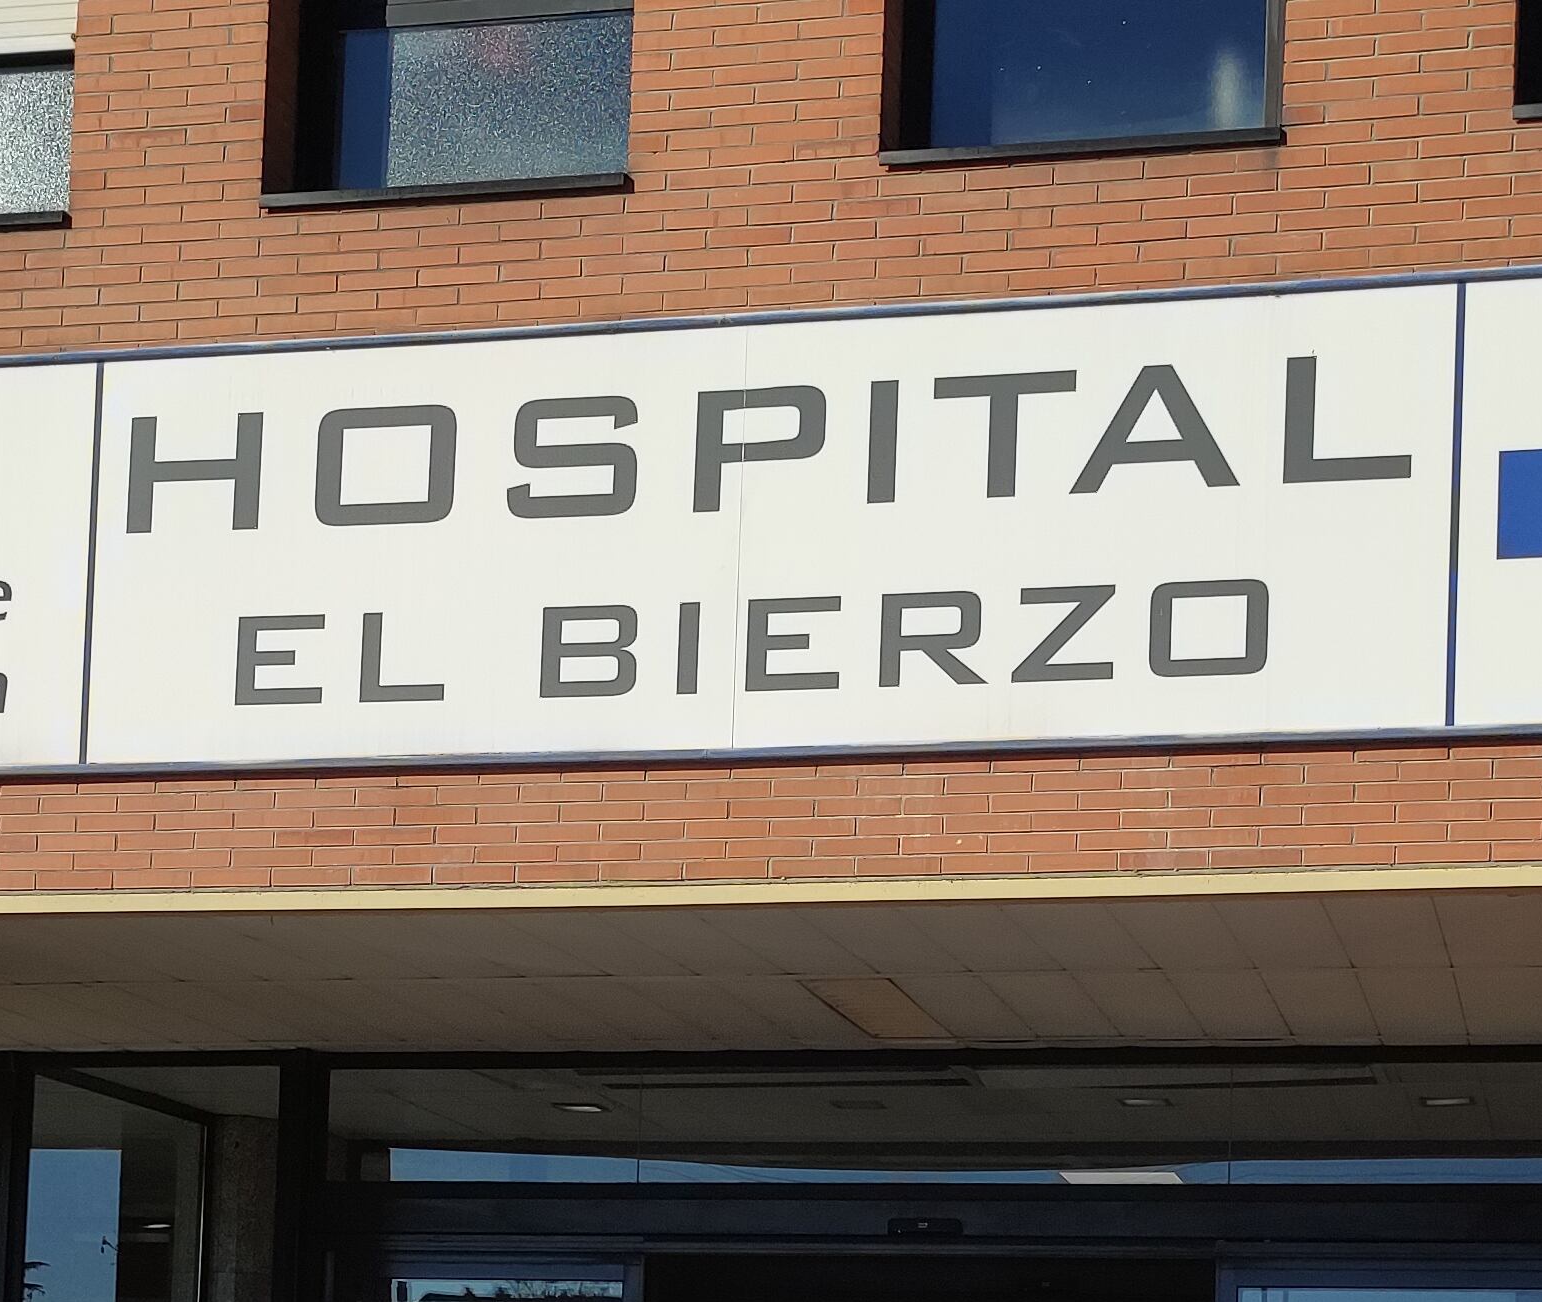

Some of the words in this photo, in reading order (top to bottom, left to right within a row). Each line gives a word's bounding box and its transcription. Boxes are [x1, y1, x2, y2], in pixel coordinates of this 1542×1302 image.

[126, 356, 1412, 533] HOSPITAL
[235, 612, 444, 705] EL
[540, 579, 1269, 698] BIERZO
